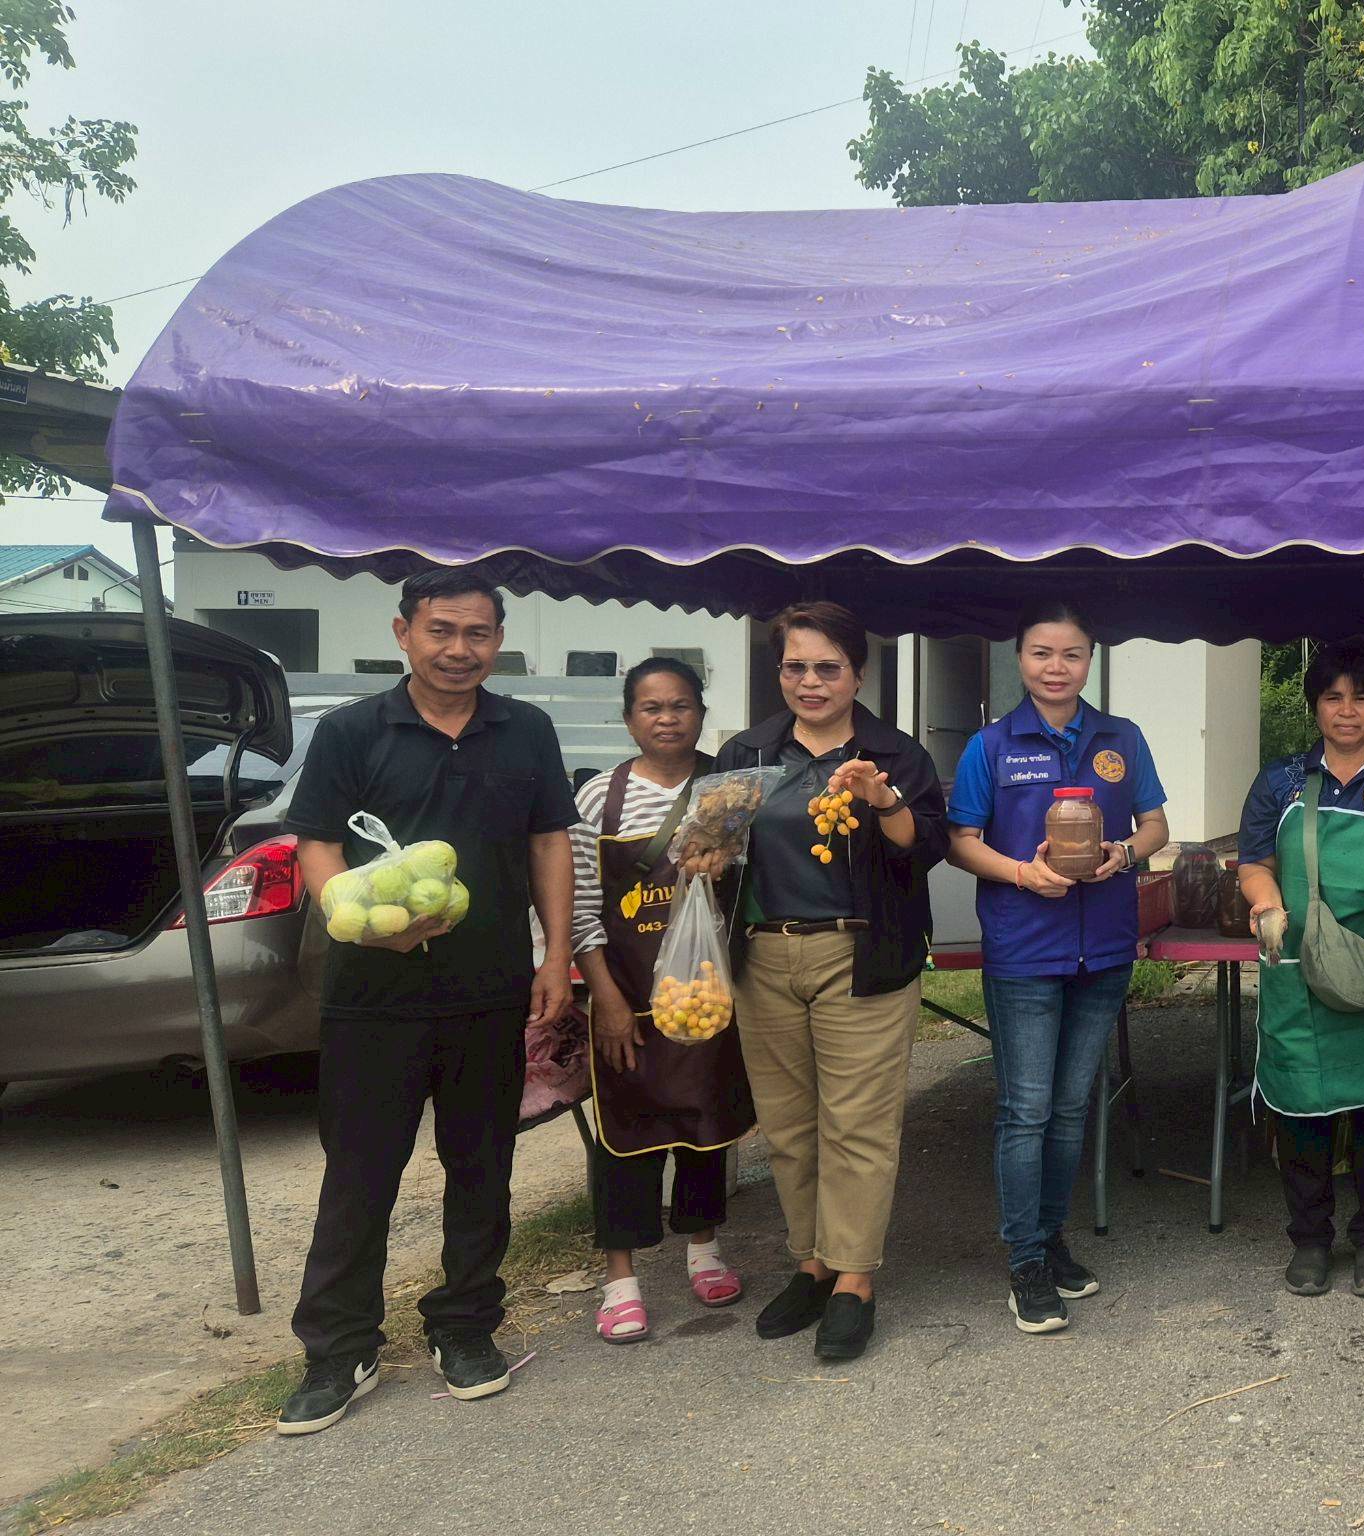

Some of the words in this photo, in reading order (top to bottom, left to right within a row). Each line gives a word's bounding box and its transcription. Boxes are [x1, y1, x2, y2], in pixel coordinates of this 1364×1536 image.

[1010, 770, 1049, 782] ปลัดอำเภอ
[637, 920, 668, 933] 043-
